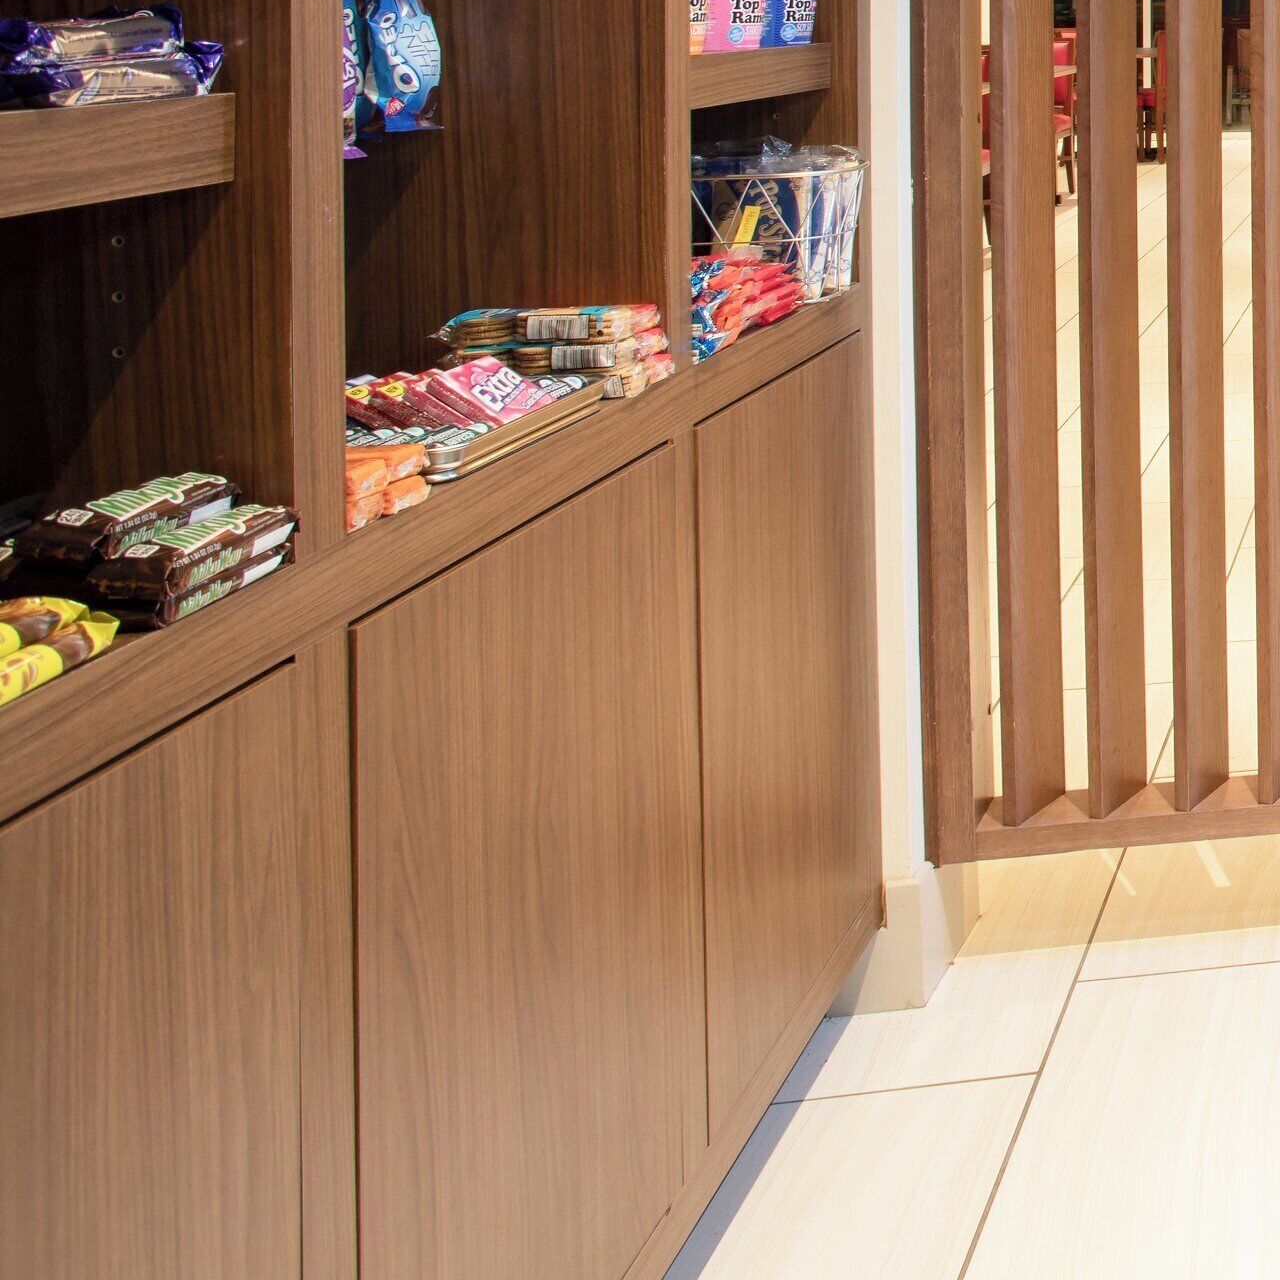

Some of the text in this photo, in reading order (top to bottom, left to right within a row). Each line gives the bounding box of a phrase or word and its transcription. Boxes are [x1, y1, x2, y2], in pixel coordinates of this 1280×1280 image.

[381, 11, 421, 95] OREO
[400, 23, 431, 79] THINS
[420, 20, 439, 78] BITES
[471, 366, 525, 412] Extra
